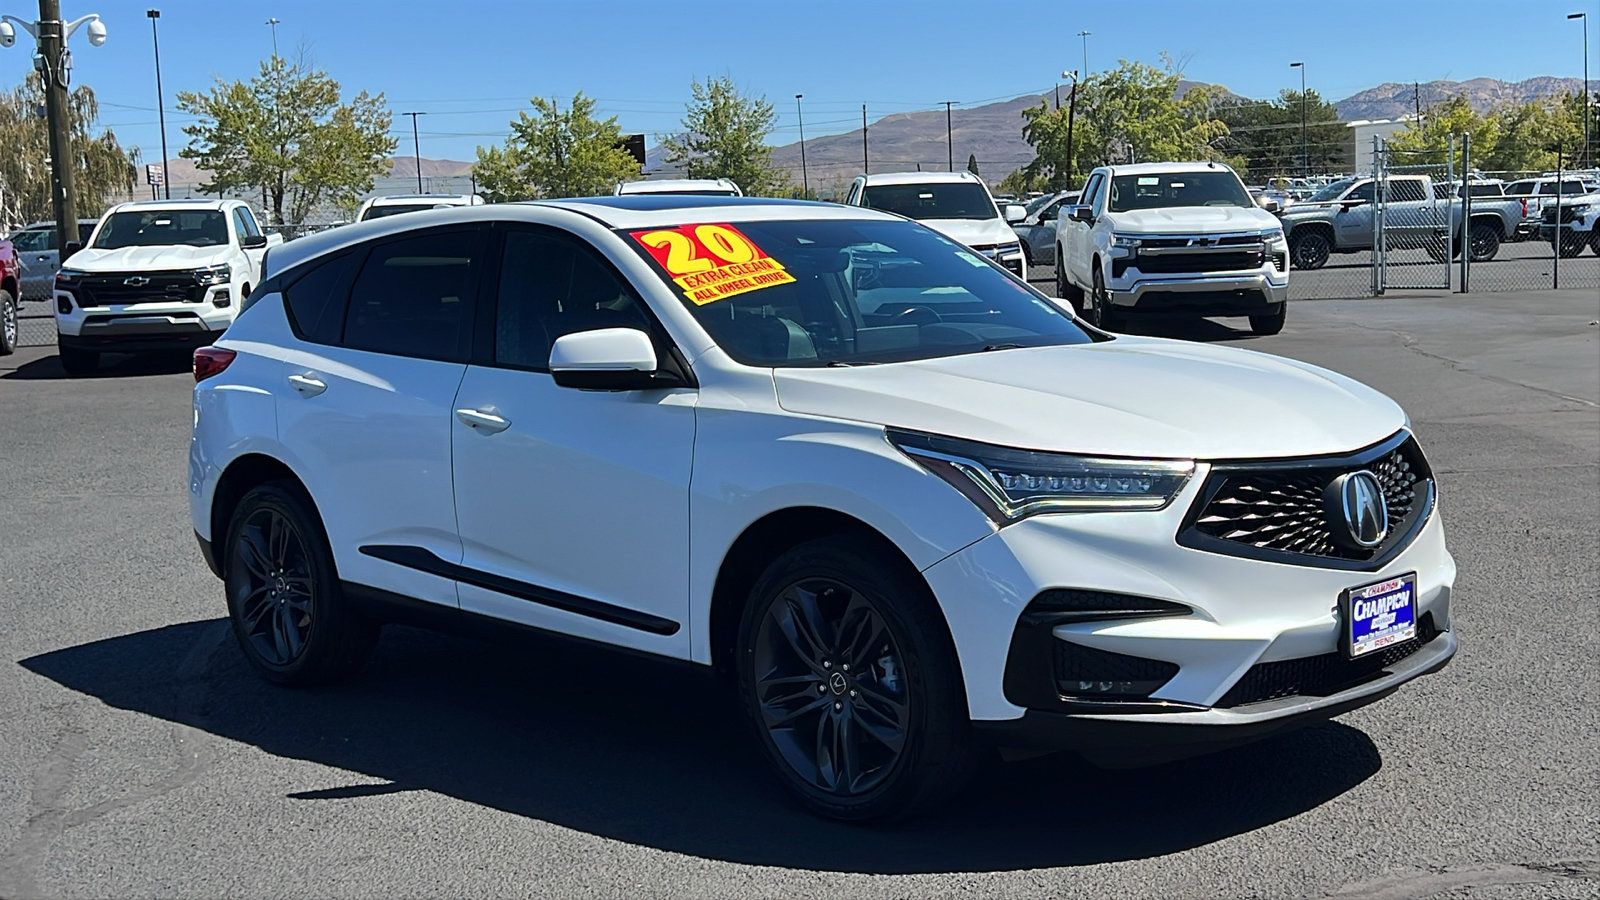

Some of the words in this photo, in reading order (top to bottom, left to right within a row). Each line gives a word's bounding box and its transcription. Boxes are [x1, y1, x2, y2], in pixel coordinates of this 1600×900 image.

[640, 224, 758, 274] 20
[683, 267, 731, 288] EXTRA
[731, 260, 773, 278] CLEAN
[693, 290, 717, 302] ALL
[716, 278, 753, 296] WHEEL
[752, 272, 788, 285] DRIVE
[1353, 590, 1410, 622] CHAMPION
[1374, 635, 1395, 647] RENO
